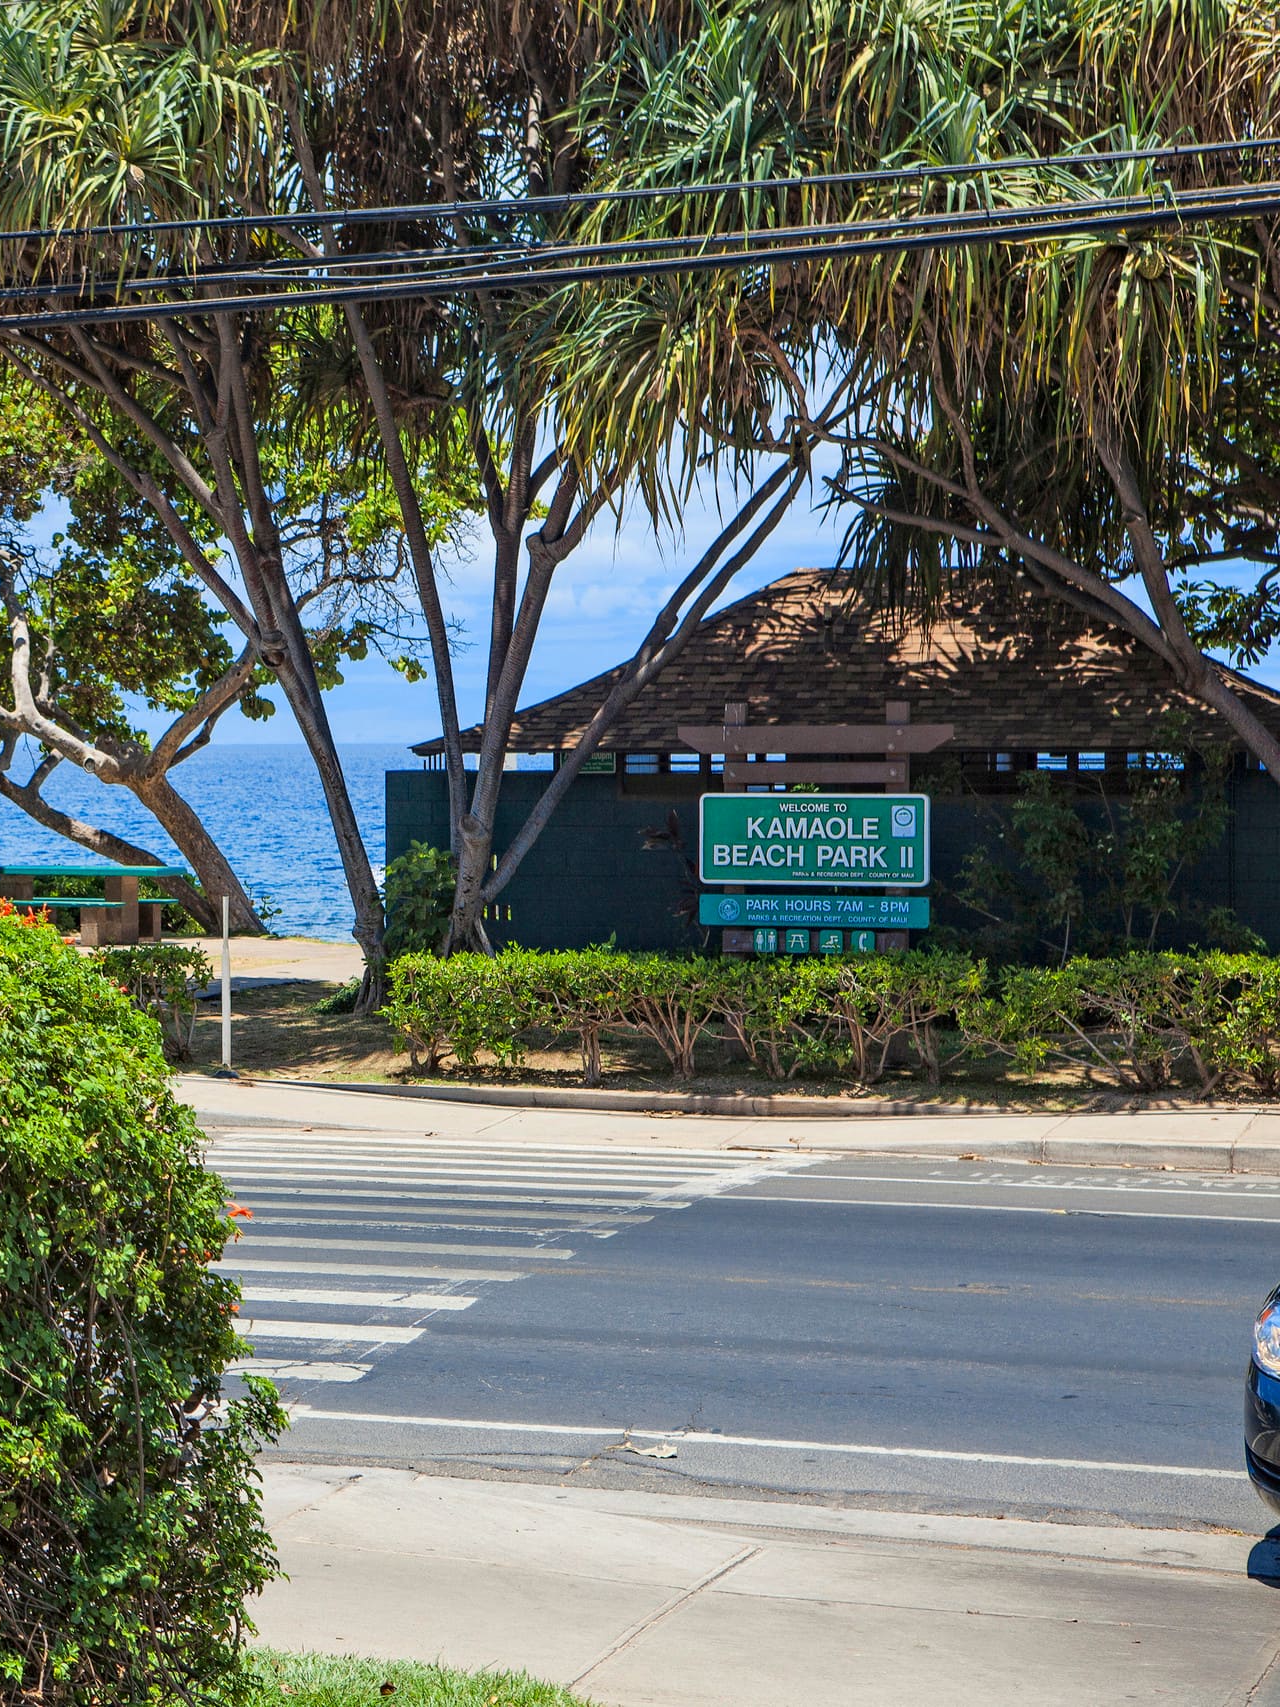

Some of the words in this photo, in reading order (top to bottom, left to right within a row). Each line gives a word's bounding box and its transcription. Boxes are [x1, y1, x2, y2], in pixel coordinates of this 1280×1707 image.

[779, 803, 830, 813] WELCOME
[833, 803, 848, 813] TO
[746, 816, 880, 840] KAMAOLE
[712, 844, 805, 868] BEACH
[816, 845, 888, 869] PARK
[900, 846, 914, 869] II
[746, 899, 780, 911] PARK
[785, 899, 832, 912] HOURS
[836, 900, 863, 913] 7AM
[880, 901, 910, 913] 8PM
[779, 914, 822, 922] RECREATION
[890, 916, 908, 924] MAUI
